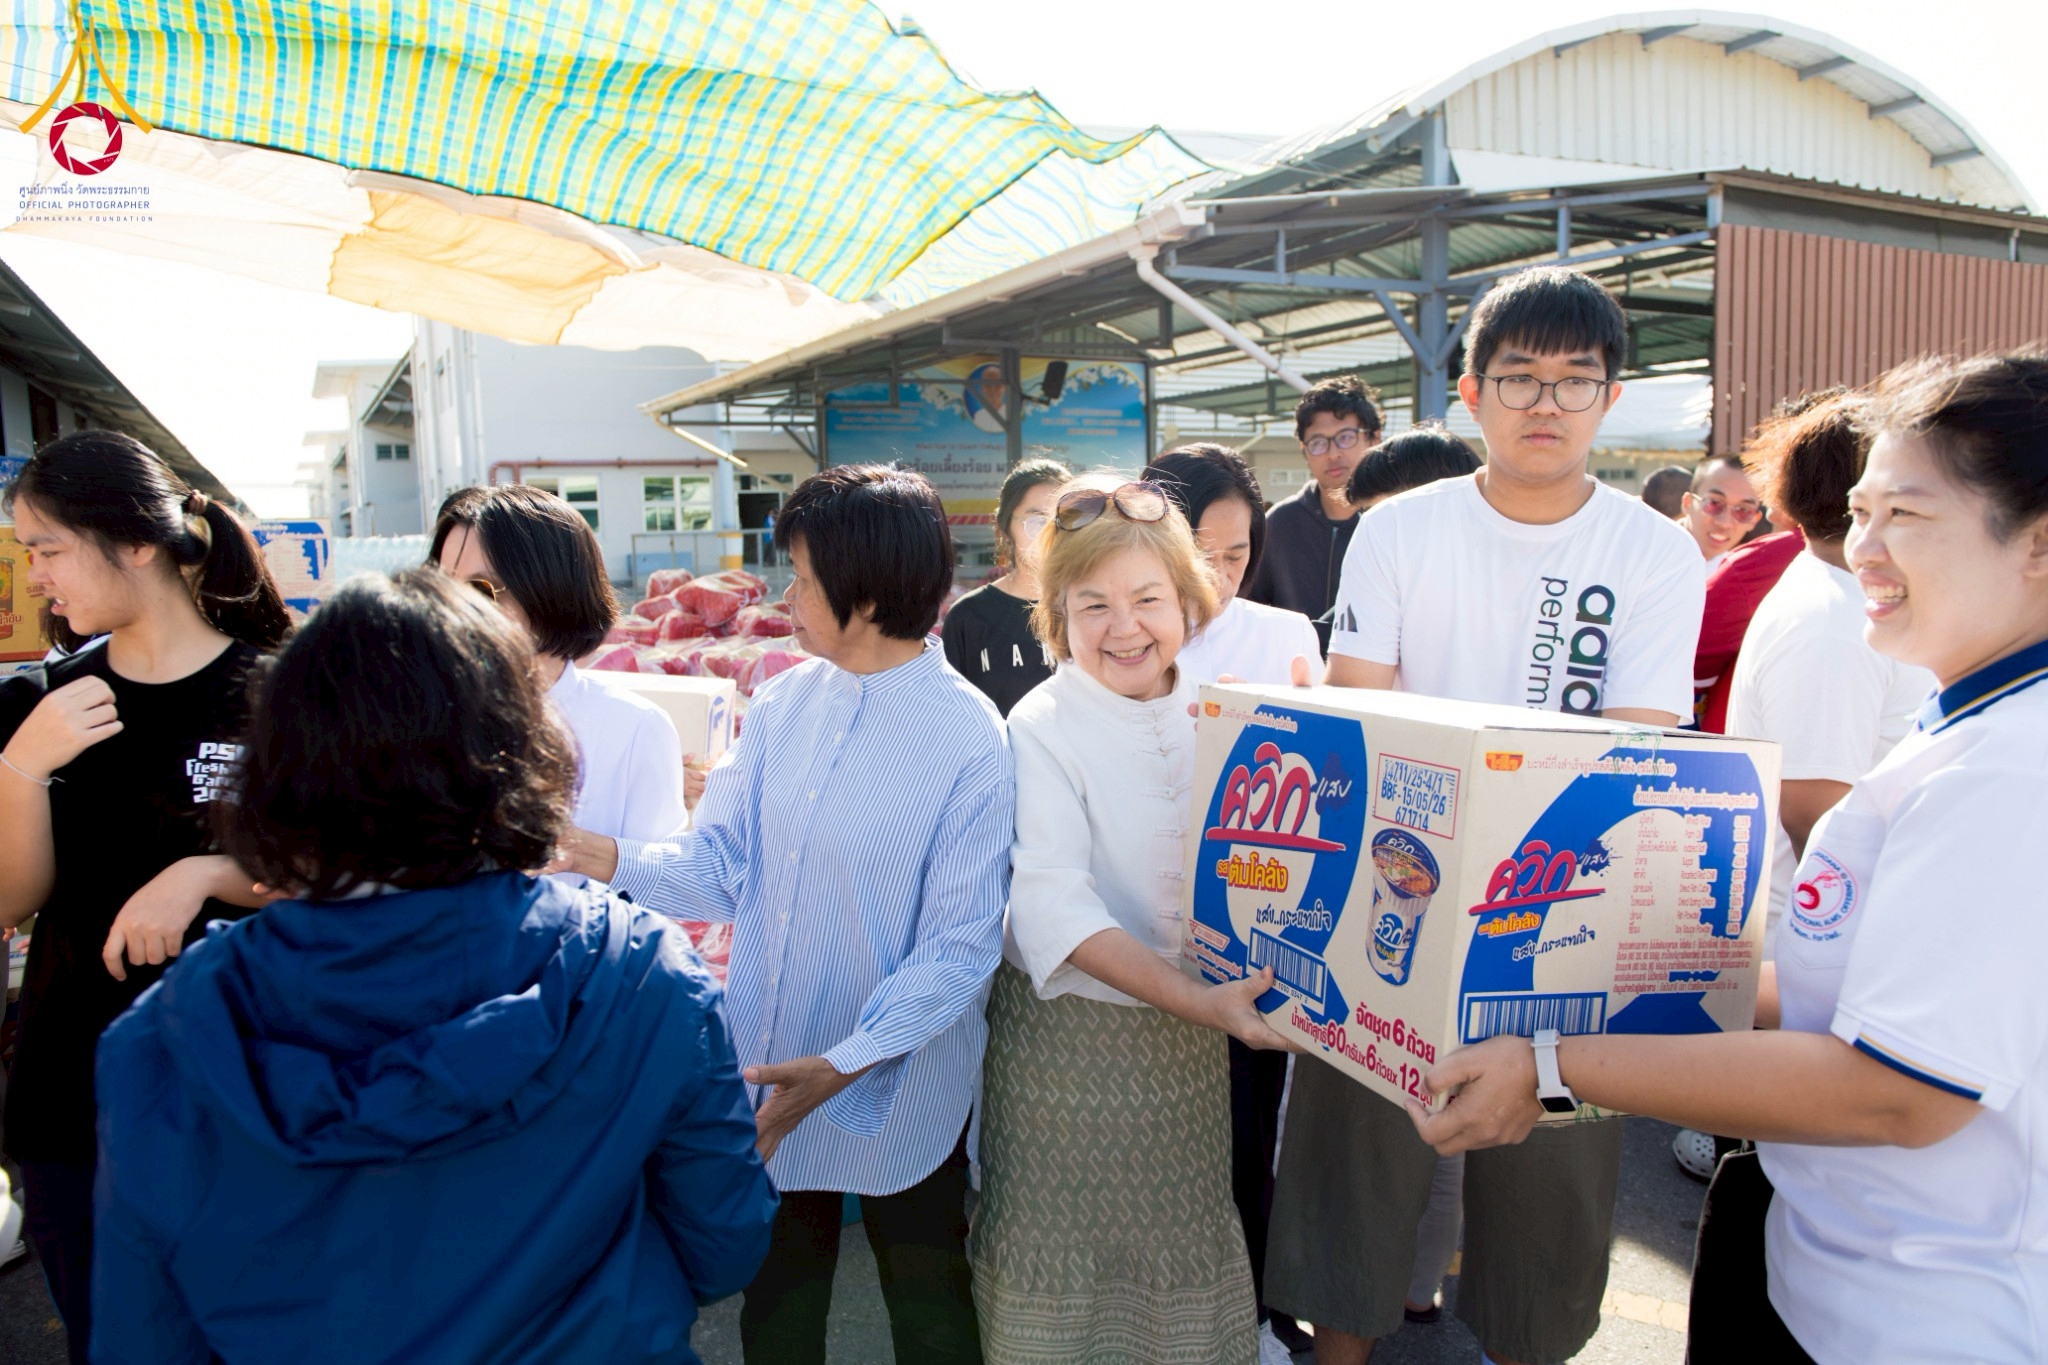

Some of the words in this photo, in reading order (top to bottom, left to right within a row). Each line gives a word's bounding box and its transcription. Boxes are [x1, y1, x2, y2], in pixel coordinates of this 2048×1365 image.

[1526, 576, 1569, 710] perform
[1219, 741, 1311, 837] ควิก
[1485, 840, 1577, 904] ควิก
[1392, 1018, 1405, 1047] 6
